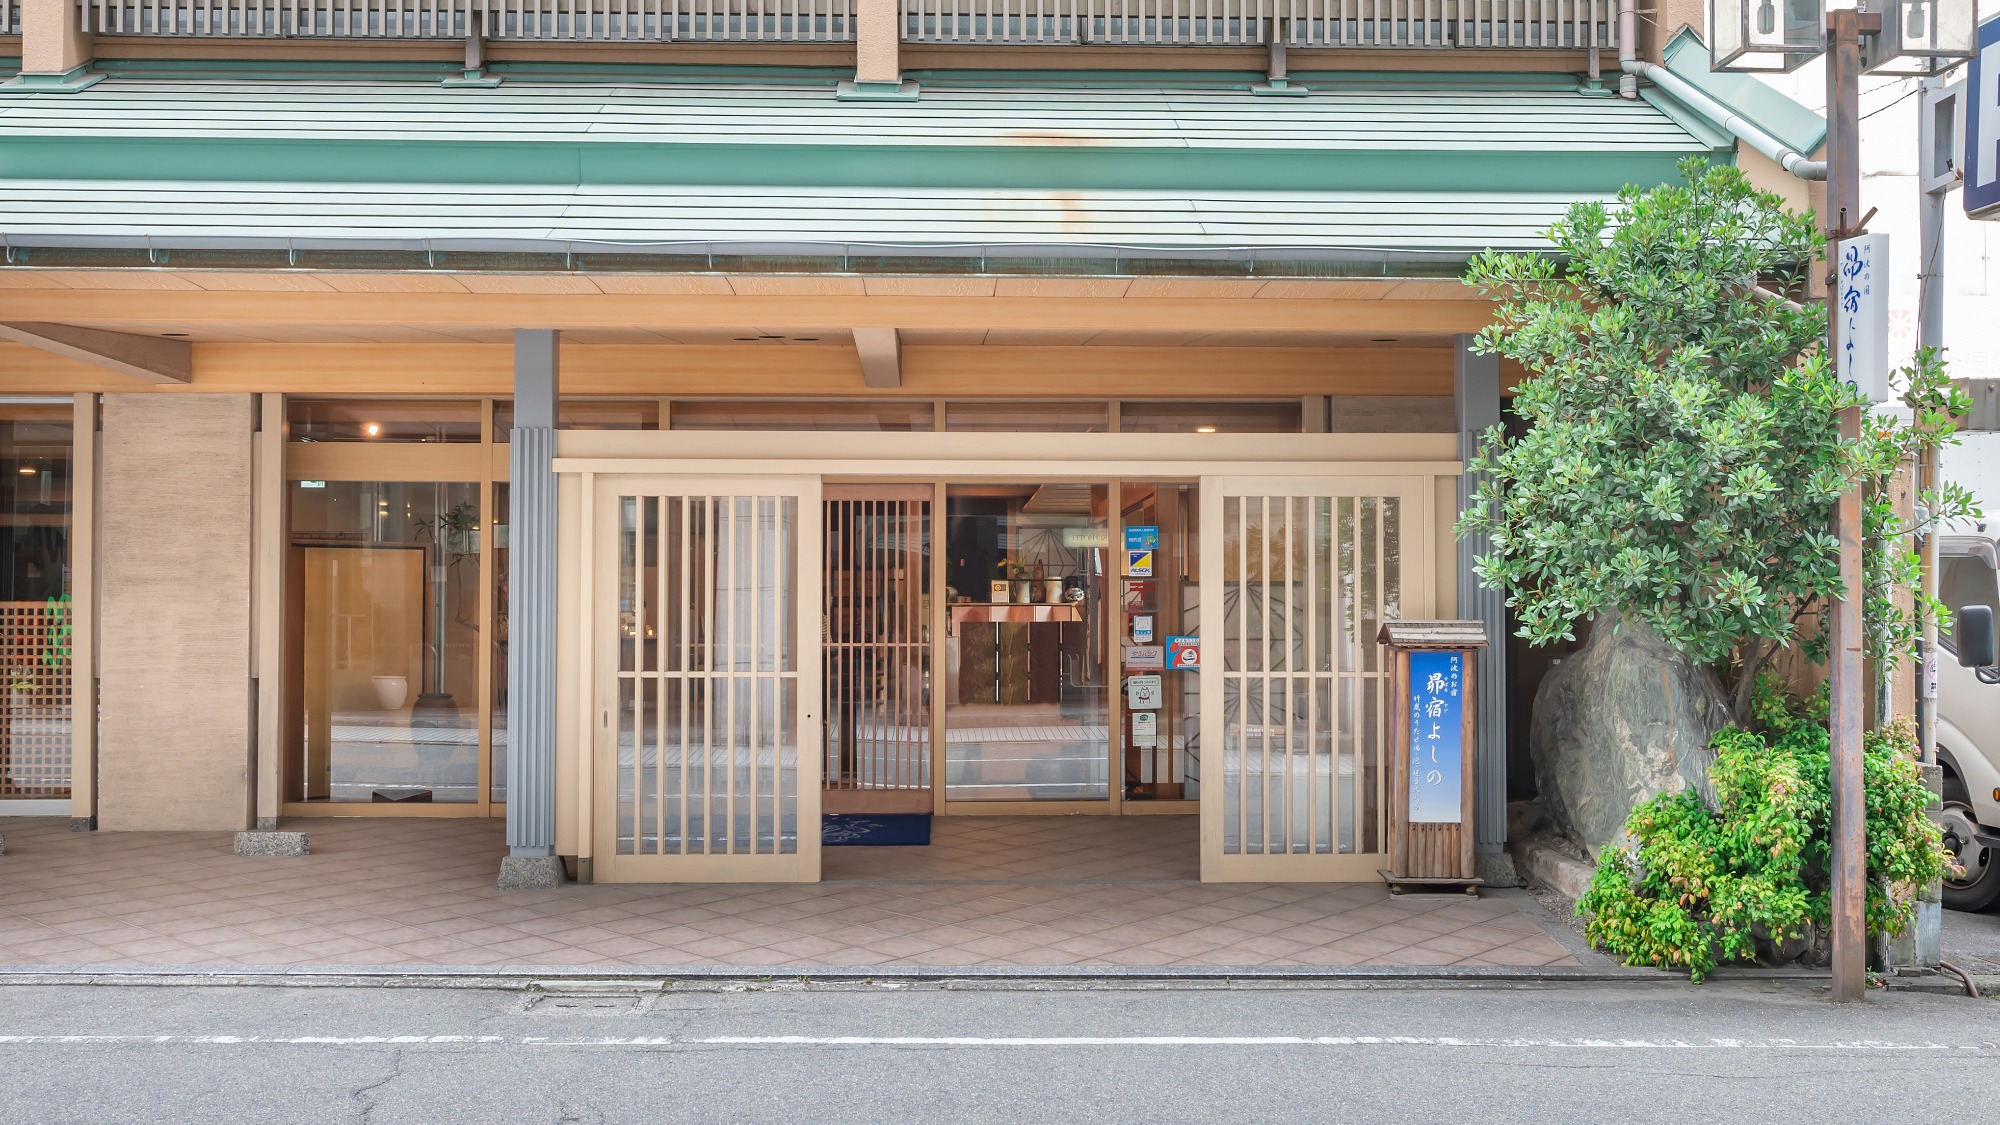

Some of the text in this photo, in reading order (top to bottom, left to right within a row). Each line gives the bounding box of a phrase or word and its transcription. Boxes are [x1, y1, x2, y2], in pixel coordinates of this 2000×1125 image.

[1450, 656, 1459, 697] 阿波のお宿
[1425, 672, 1445, 786] 昴宿よしの
